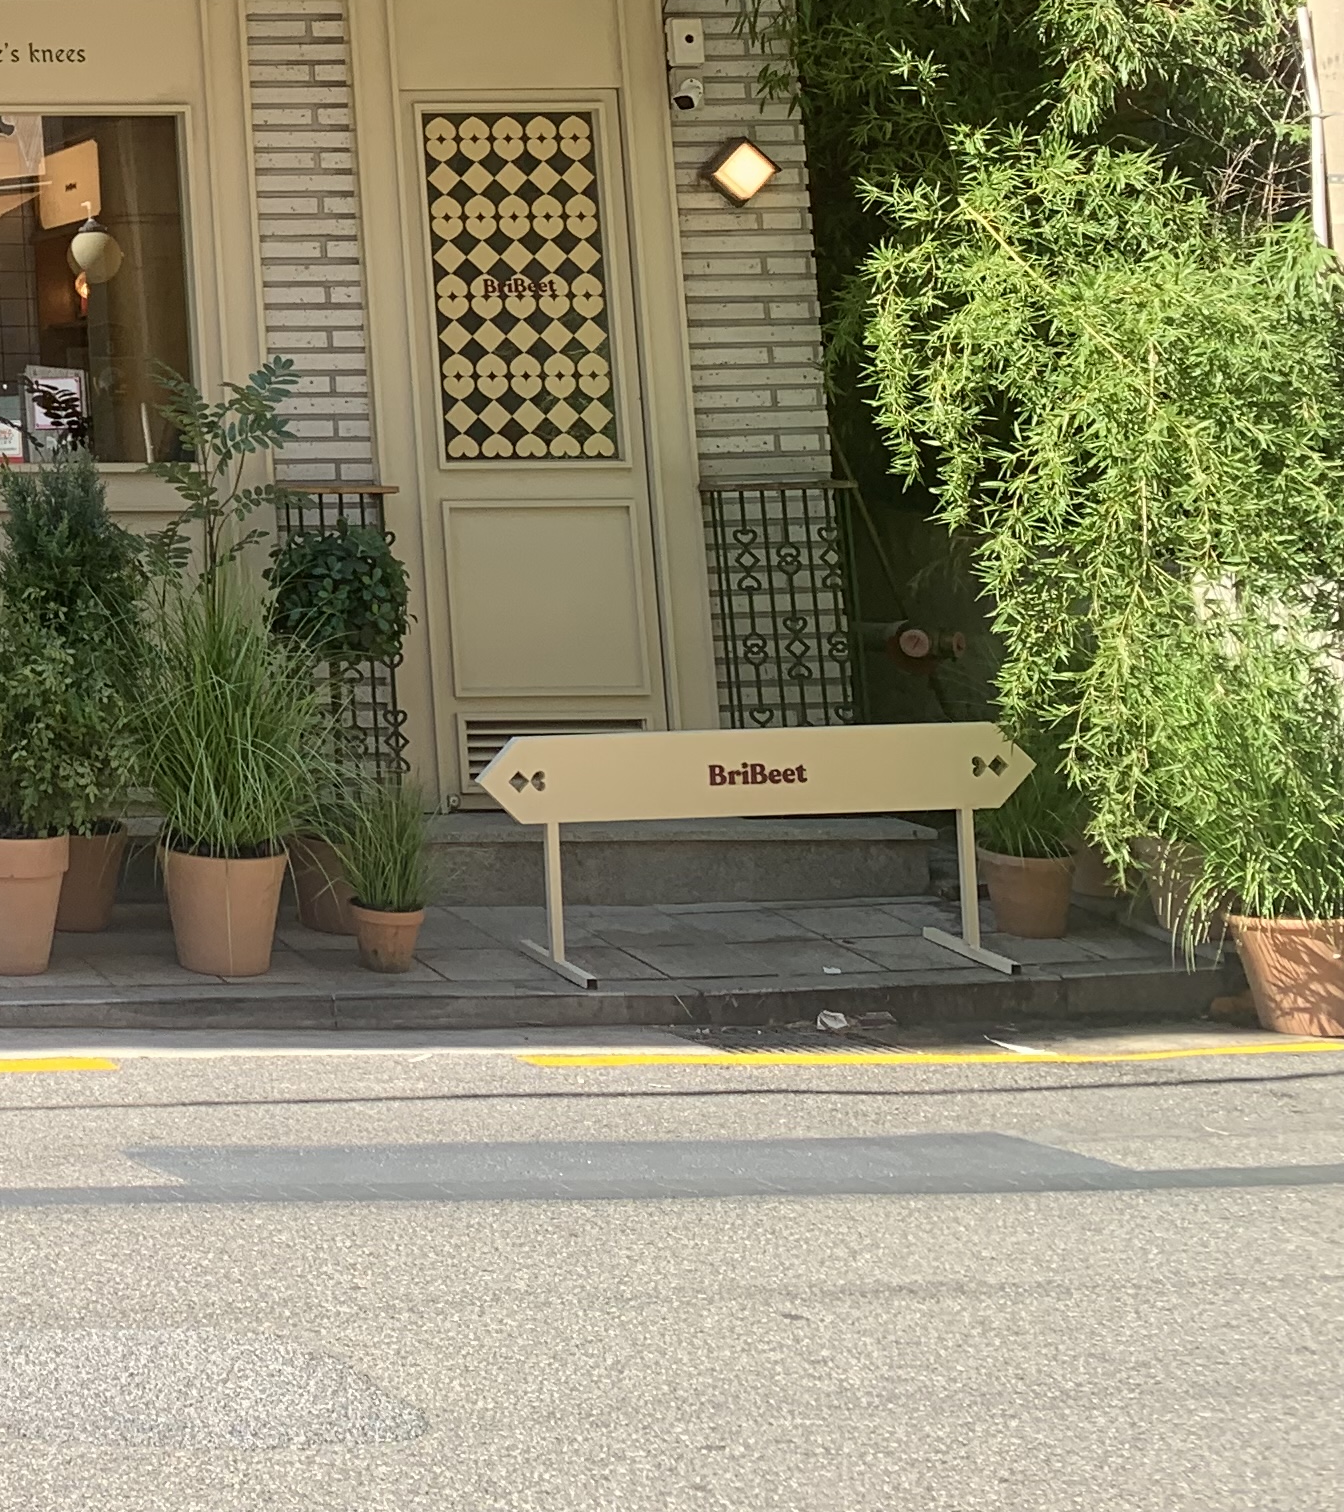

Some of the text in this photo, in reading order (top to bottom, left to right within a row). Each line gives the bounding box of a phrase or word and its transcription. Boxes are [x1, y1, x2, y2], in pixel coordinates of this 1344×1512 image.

[28, 42, 87, 64] knees
[483, 277, 558, 295] BriBeet
[708, 762, 808, 786] BriBeet
